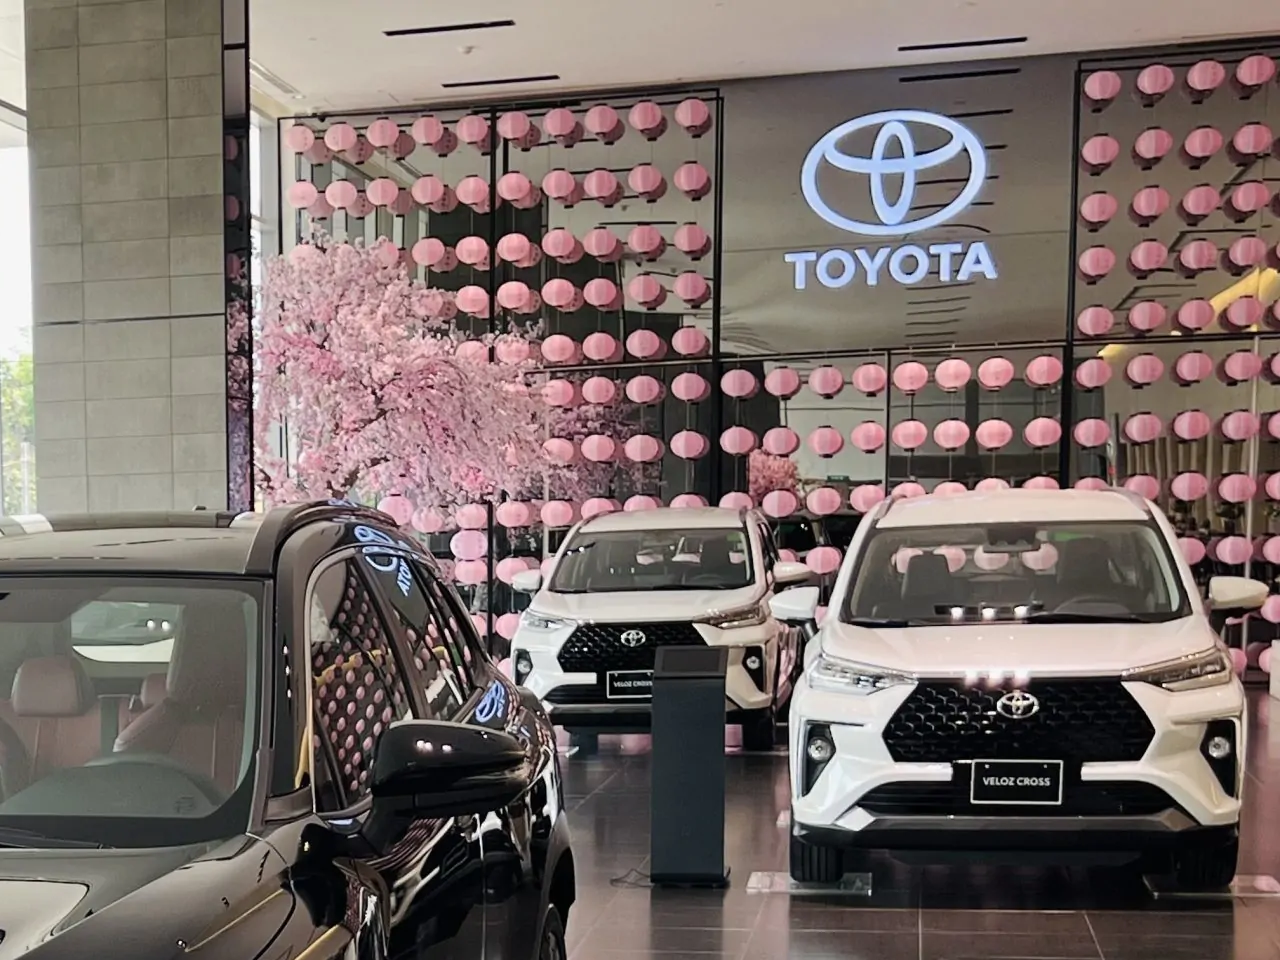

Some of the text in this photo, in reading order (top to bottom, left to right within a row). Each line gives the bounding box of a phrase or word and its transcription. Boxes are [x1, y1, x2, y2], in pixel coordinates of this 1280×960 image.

[784, 241, 998, 290] TOYOTA
[982, 776, 1052, 787] VELOZ CROSS
